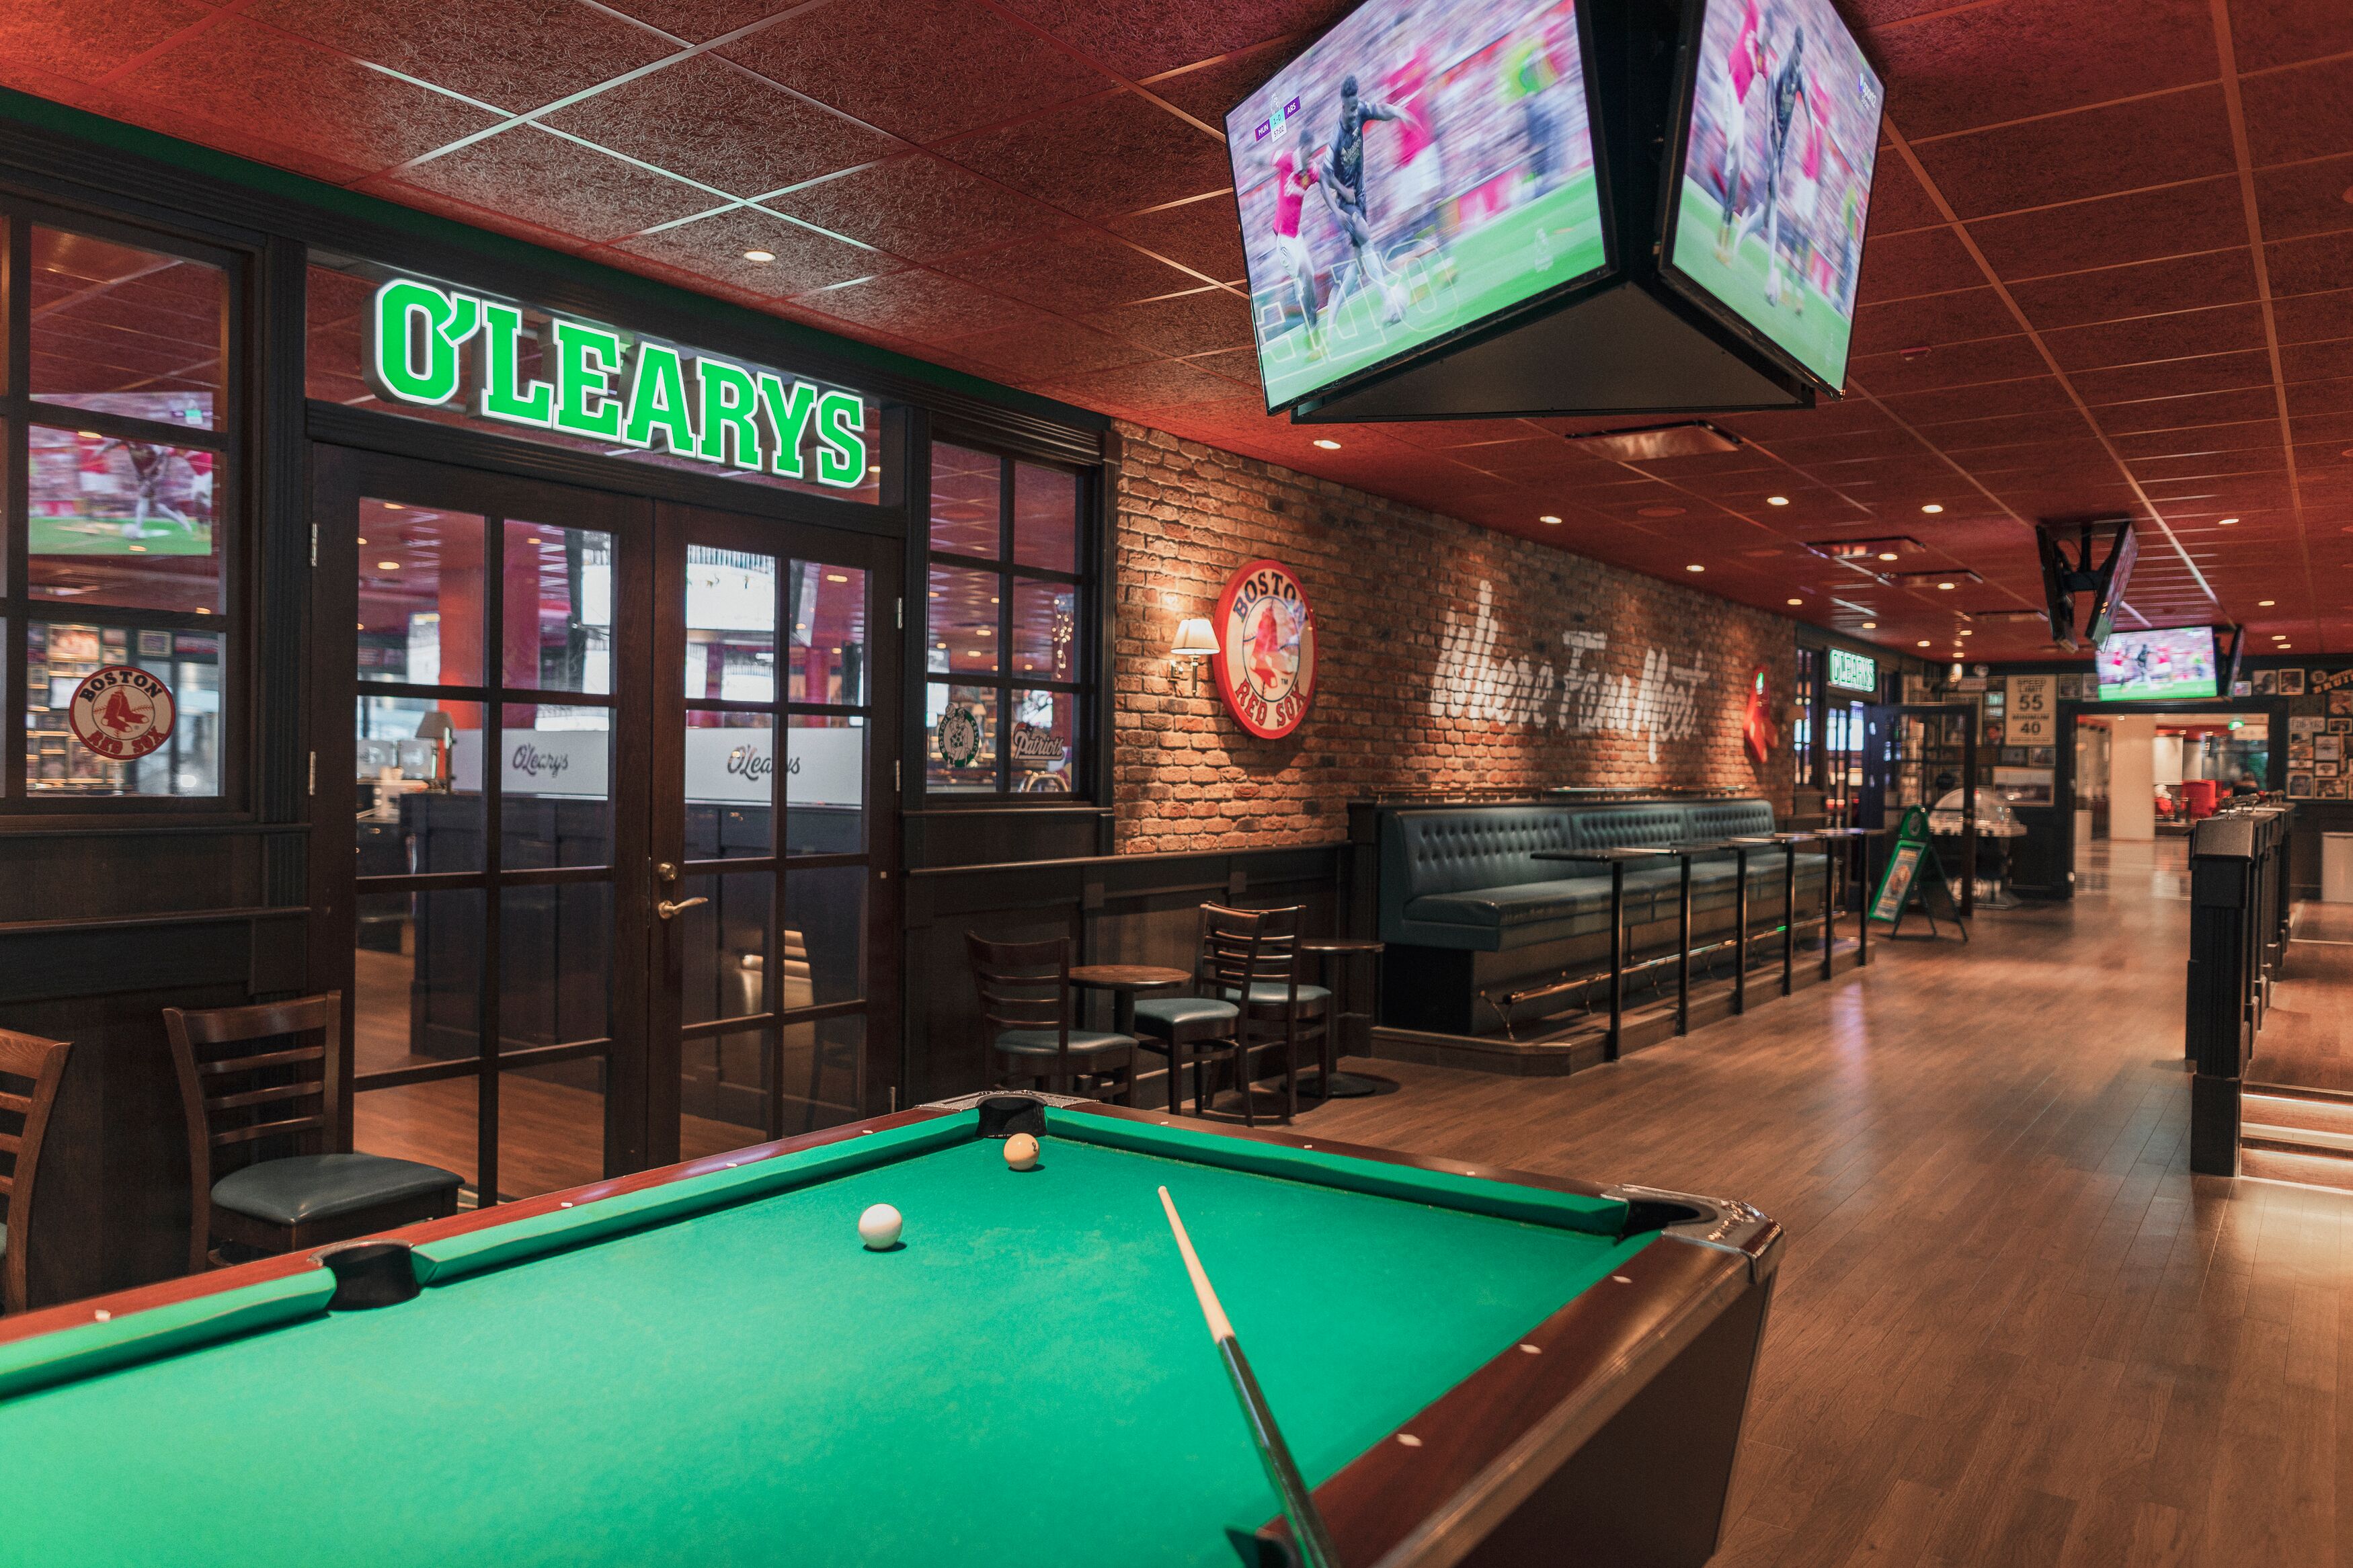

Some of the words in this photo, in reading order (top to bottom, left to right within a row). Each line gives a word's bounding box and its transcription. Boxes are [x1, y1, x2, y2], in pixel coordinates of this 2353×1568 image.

[1258, 124, 1269, 136] MUN
[1273, 114, 1281, 125] 1-0
[1287, 102, 1296, 115] ARS
[1274, 125, 1284, 138] 57:02
[375, 278, 866, 489] O'LEARYS
[79, 671, 163, 703] BOSTON
[1235, 678, 1268, 727] RED
[1277, 679, 1307, 727] SOX
[2020, 694, 2043, 711] 55
[87, 730, 124, 755] RED
[132, 725, 166, 754] SOX
[2020, 721, 2041, 735] 40
[513, 743, 569, 778] O'Learys
[1014, 729, 1064, 760] Patriots
[727, 744, 801, 781] O'Leas
